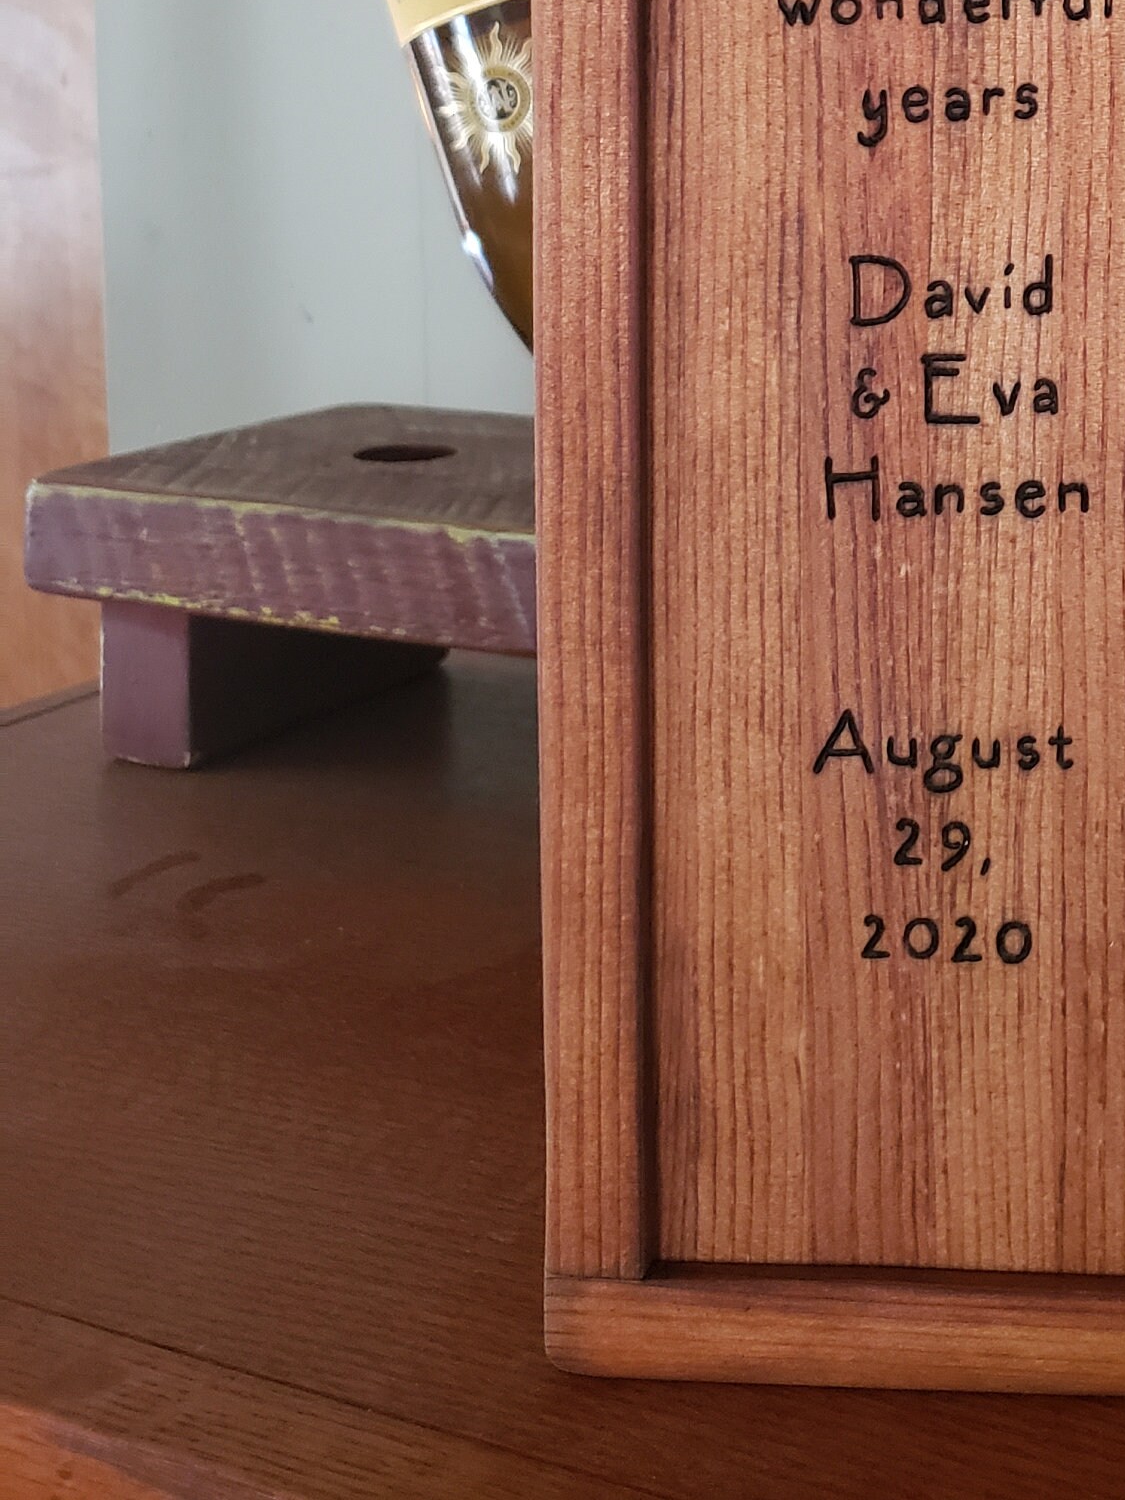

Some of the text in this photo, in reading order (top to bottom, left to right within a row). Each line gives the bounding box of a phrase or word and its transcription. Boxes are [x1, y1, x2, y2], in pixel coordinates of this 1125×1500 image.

[856, 82, 1040, 148] years
[848, 254, 1055, 327] David
[851, 353, 1060, 424] & Eva
[823, 455, 1090, 522] Hansen
[812, 708, 1075, 793] August
[894, 818, 992, 876] 29,
[860, 914, 1033, 964] 2020
